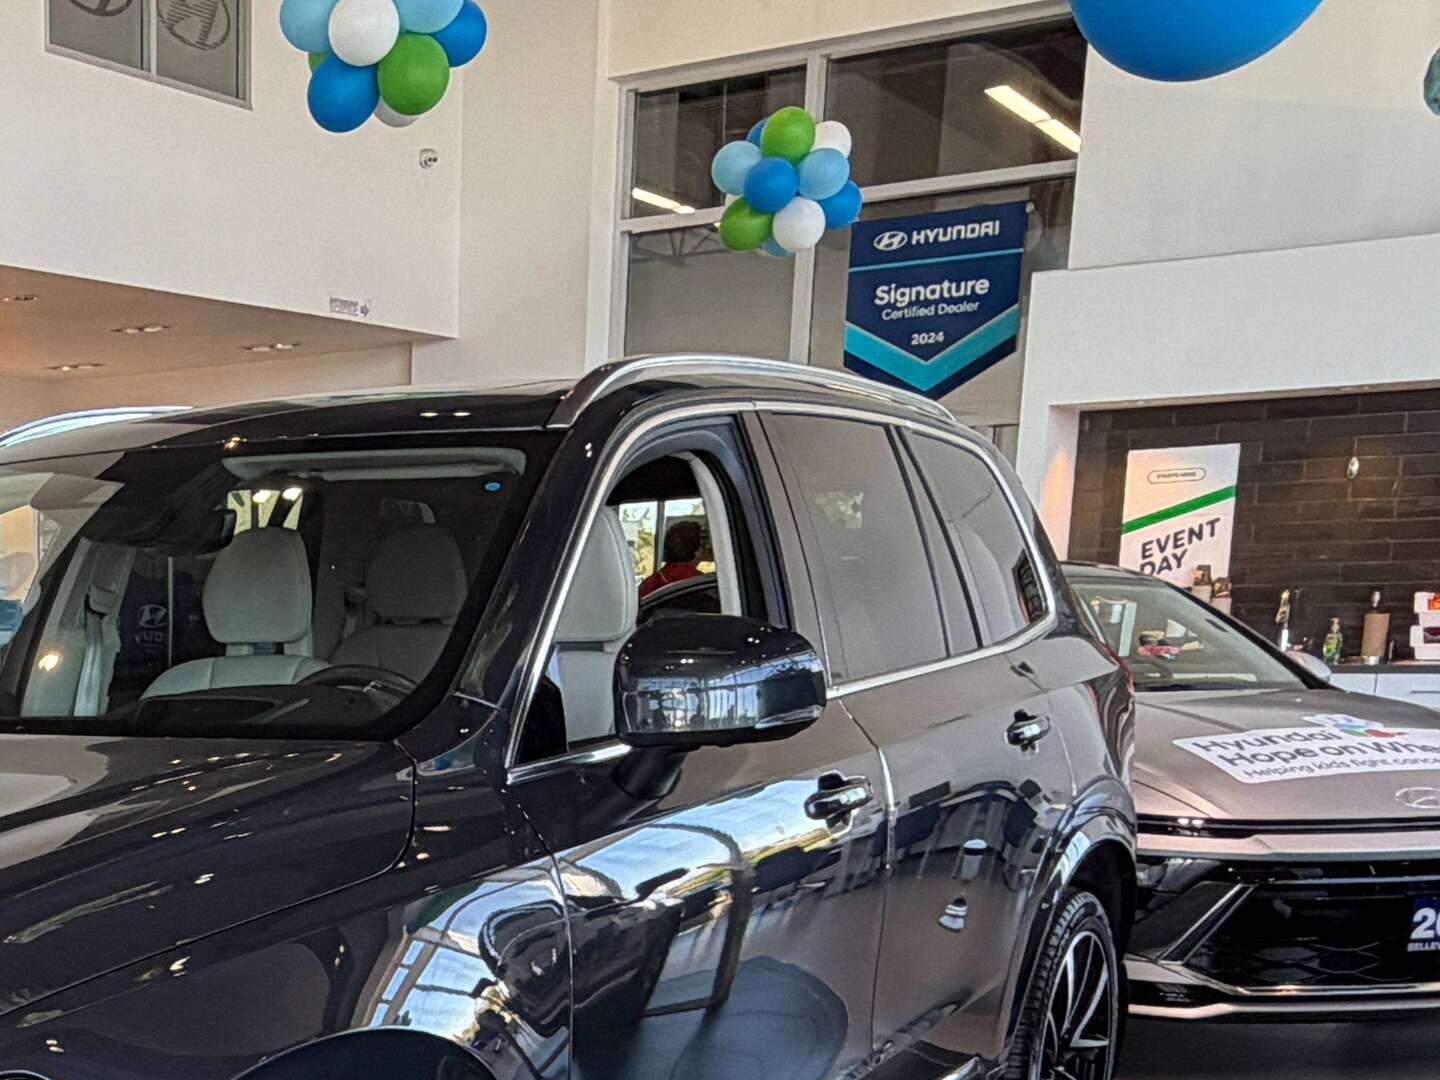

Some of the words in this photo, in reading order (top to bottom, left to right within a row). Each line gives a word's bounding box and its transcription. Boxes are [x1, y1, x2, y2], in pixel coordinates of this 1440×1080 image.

[911, 220, 1001, 245] HYUNDAI
[873, 278, 991, 307] Signature
[881, 304, 936, 321] Certified
[937, 301, 980, 316] Dealer
[911, 331, 945, 345] 2024
[1141, 517, 1222, 560] EVENT
[1140, 549, 1188, 576] DAY
[1192, 729, 1343, 752] Hyundai
[1218, 747, 1319, 766] Hope
[1318, 745, 1368, 757] on
[1410, 907, 1440, 940] 2
